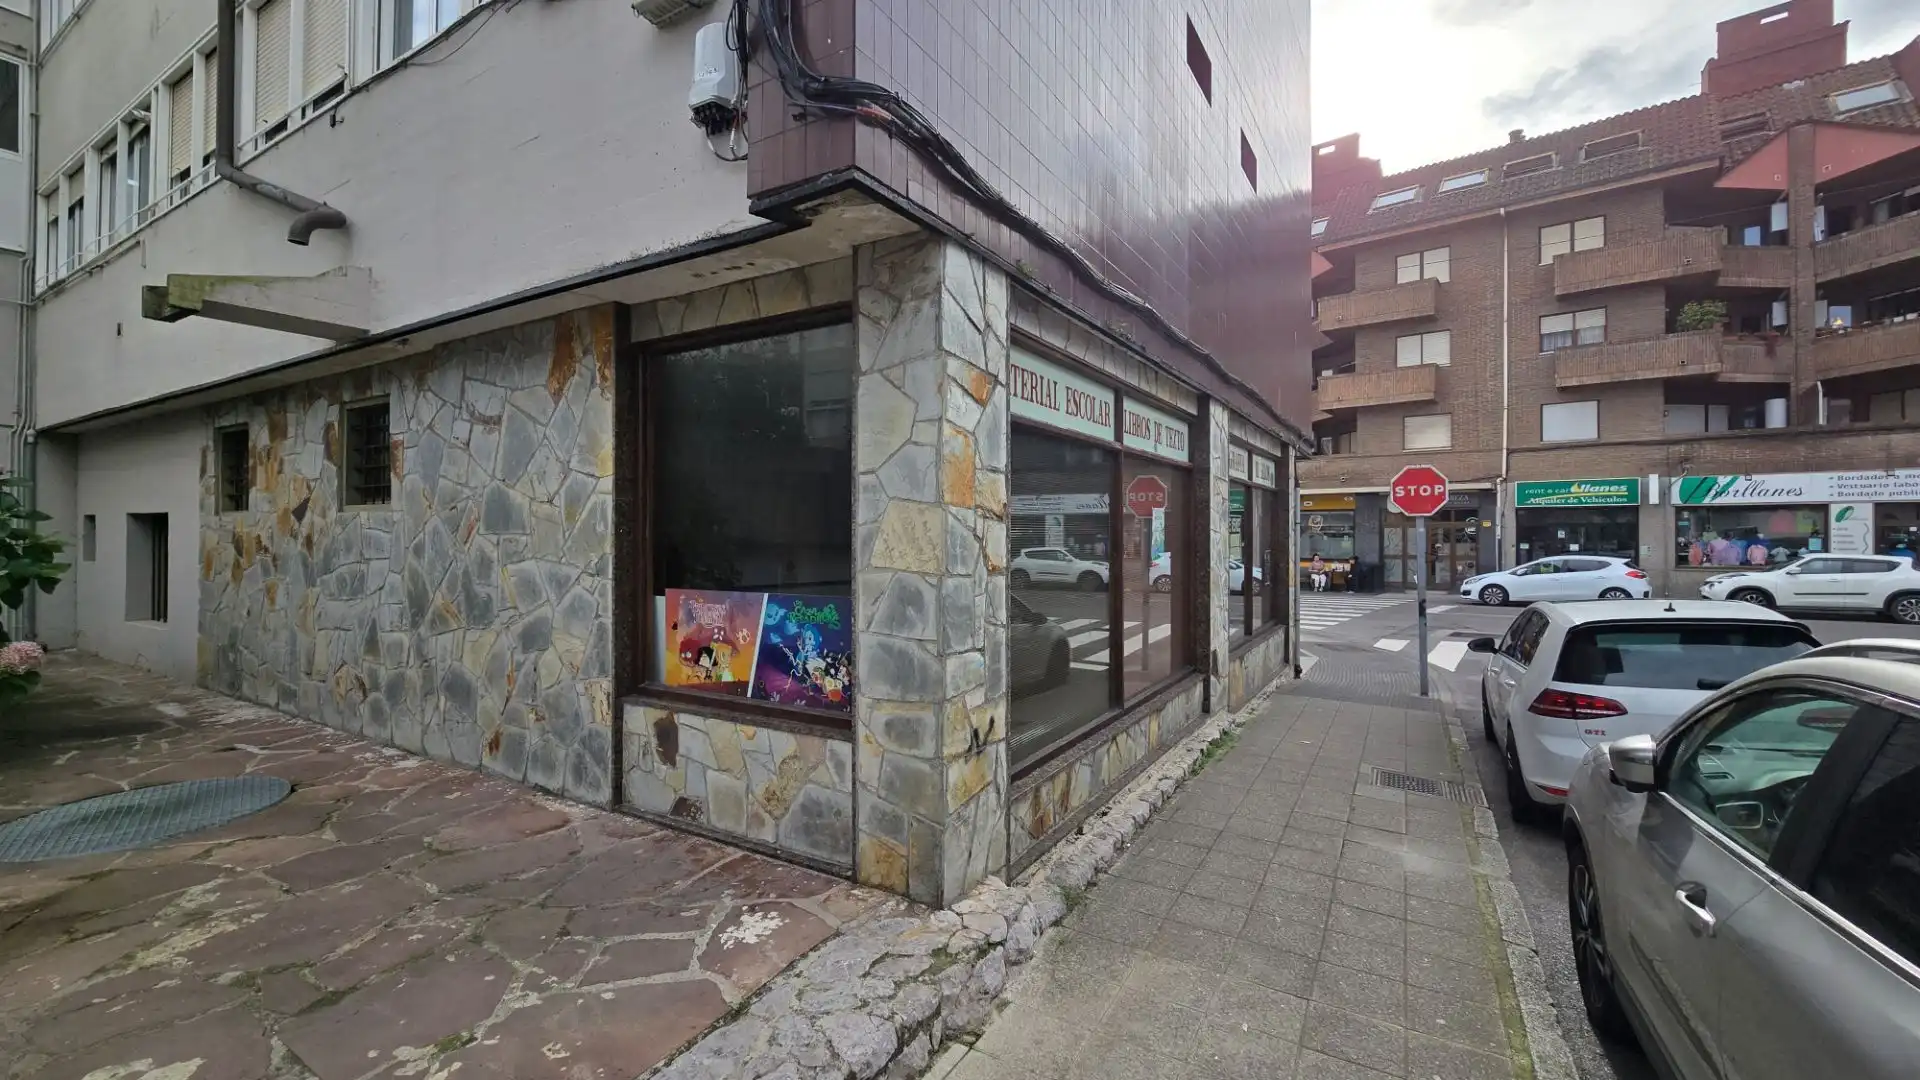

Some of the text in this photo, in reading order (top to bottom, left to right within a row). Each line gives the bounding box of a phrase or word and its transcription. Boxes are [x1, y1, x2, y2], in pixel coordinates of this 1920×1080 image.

[1010, 363, 1111, 428] TERIAL ESCOLAR
[1123, 409, 1185, 452] LIBROS DE TEXTO
[1395, 484, 1445, 497] STOP
[1837, 490, 1885, 498] Bordado
[1525, 496, 1565, 505] Alquiler
